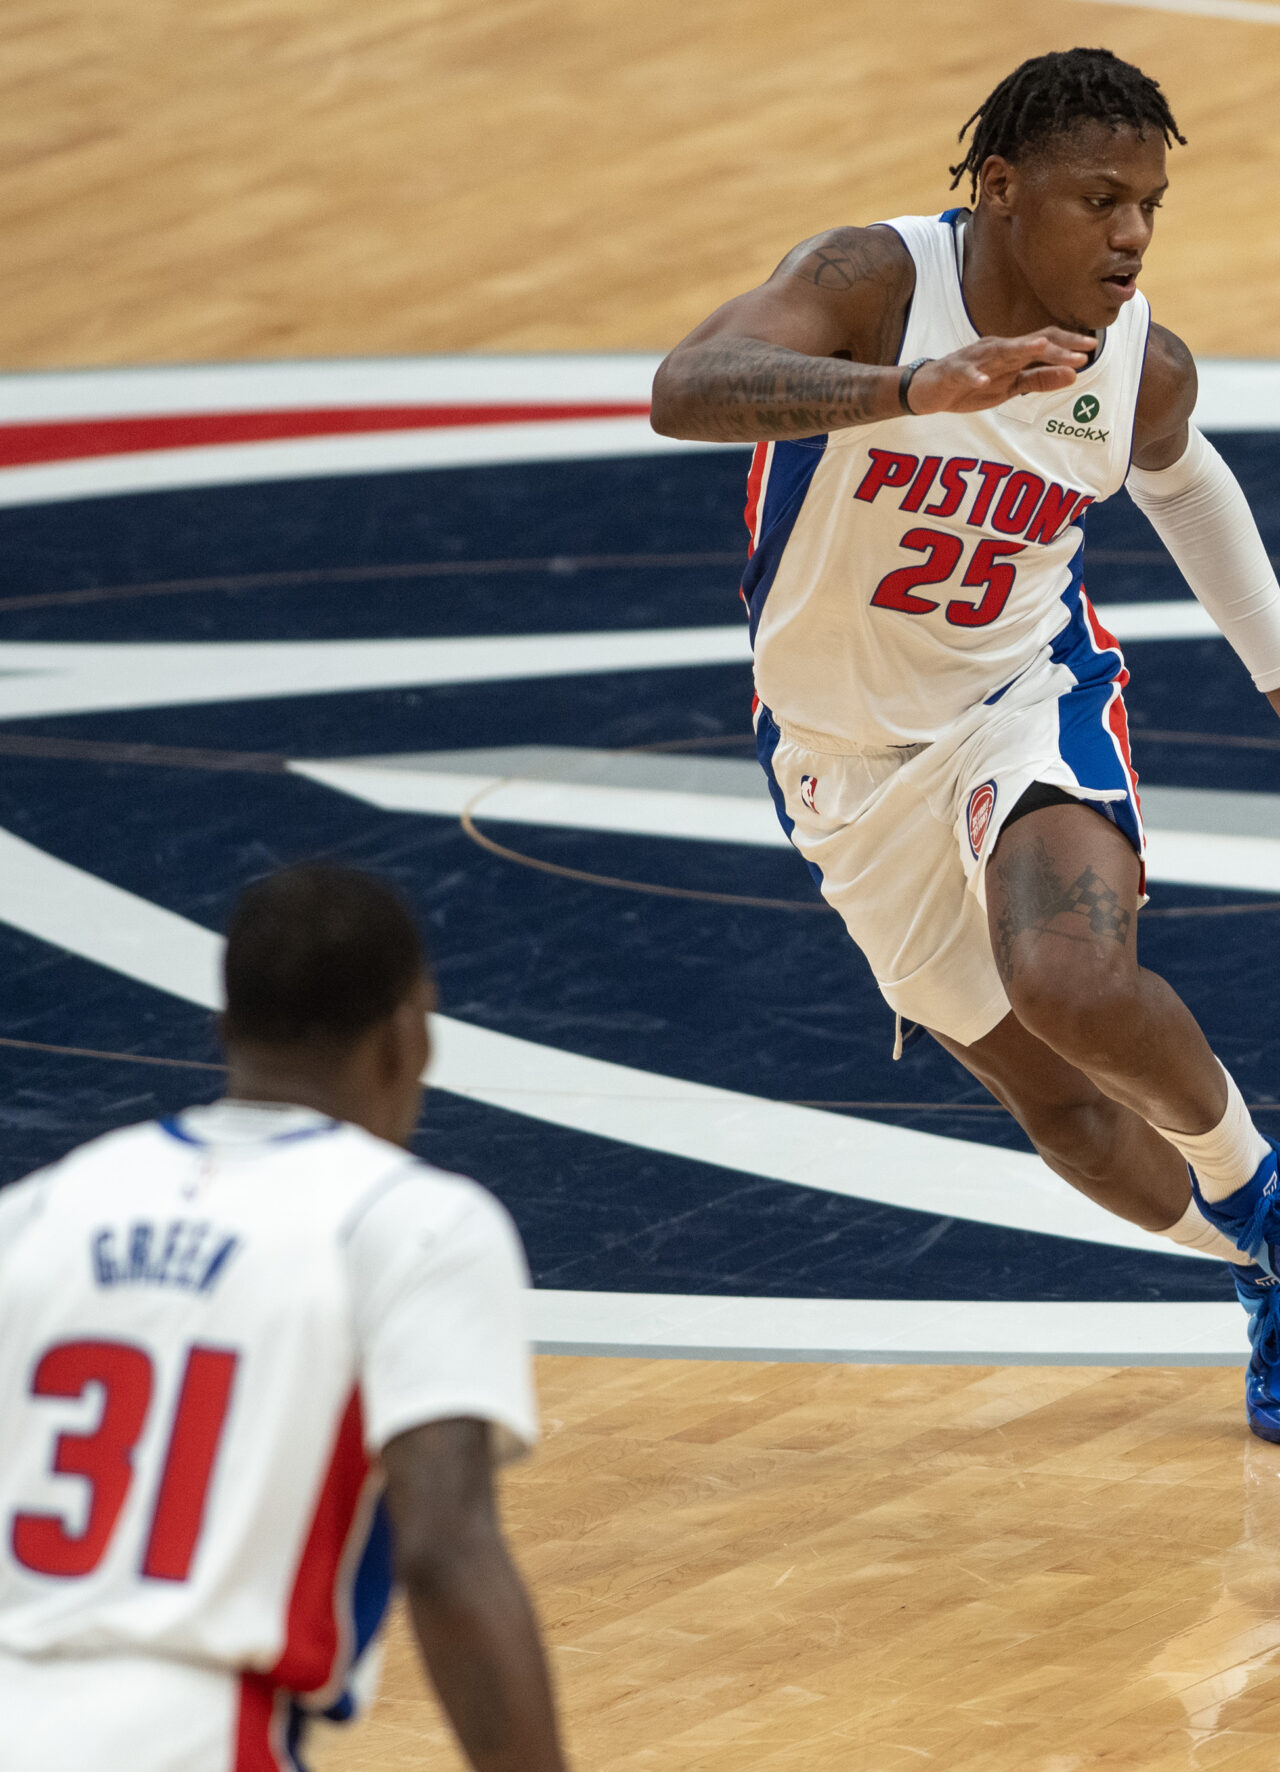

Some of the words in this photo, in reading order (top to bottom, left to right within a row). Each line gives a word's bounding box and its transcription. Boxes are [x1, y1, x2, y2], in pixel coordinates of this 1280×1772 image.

[1045, 419, 1110, 443] StockX
[869, 527, 1029, 628] 25
[90, 1217, 242, 1294] GREEN
[11, 1338, 240, 1583] 31
